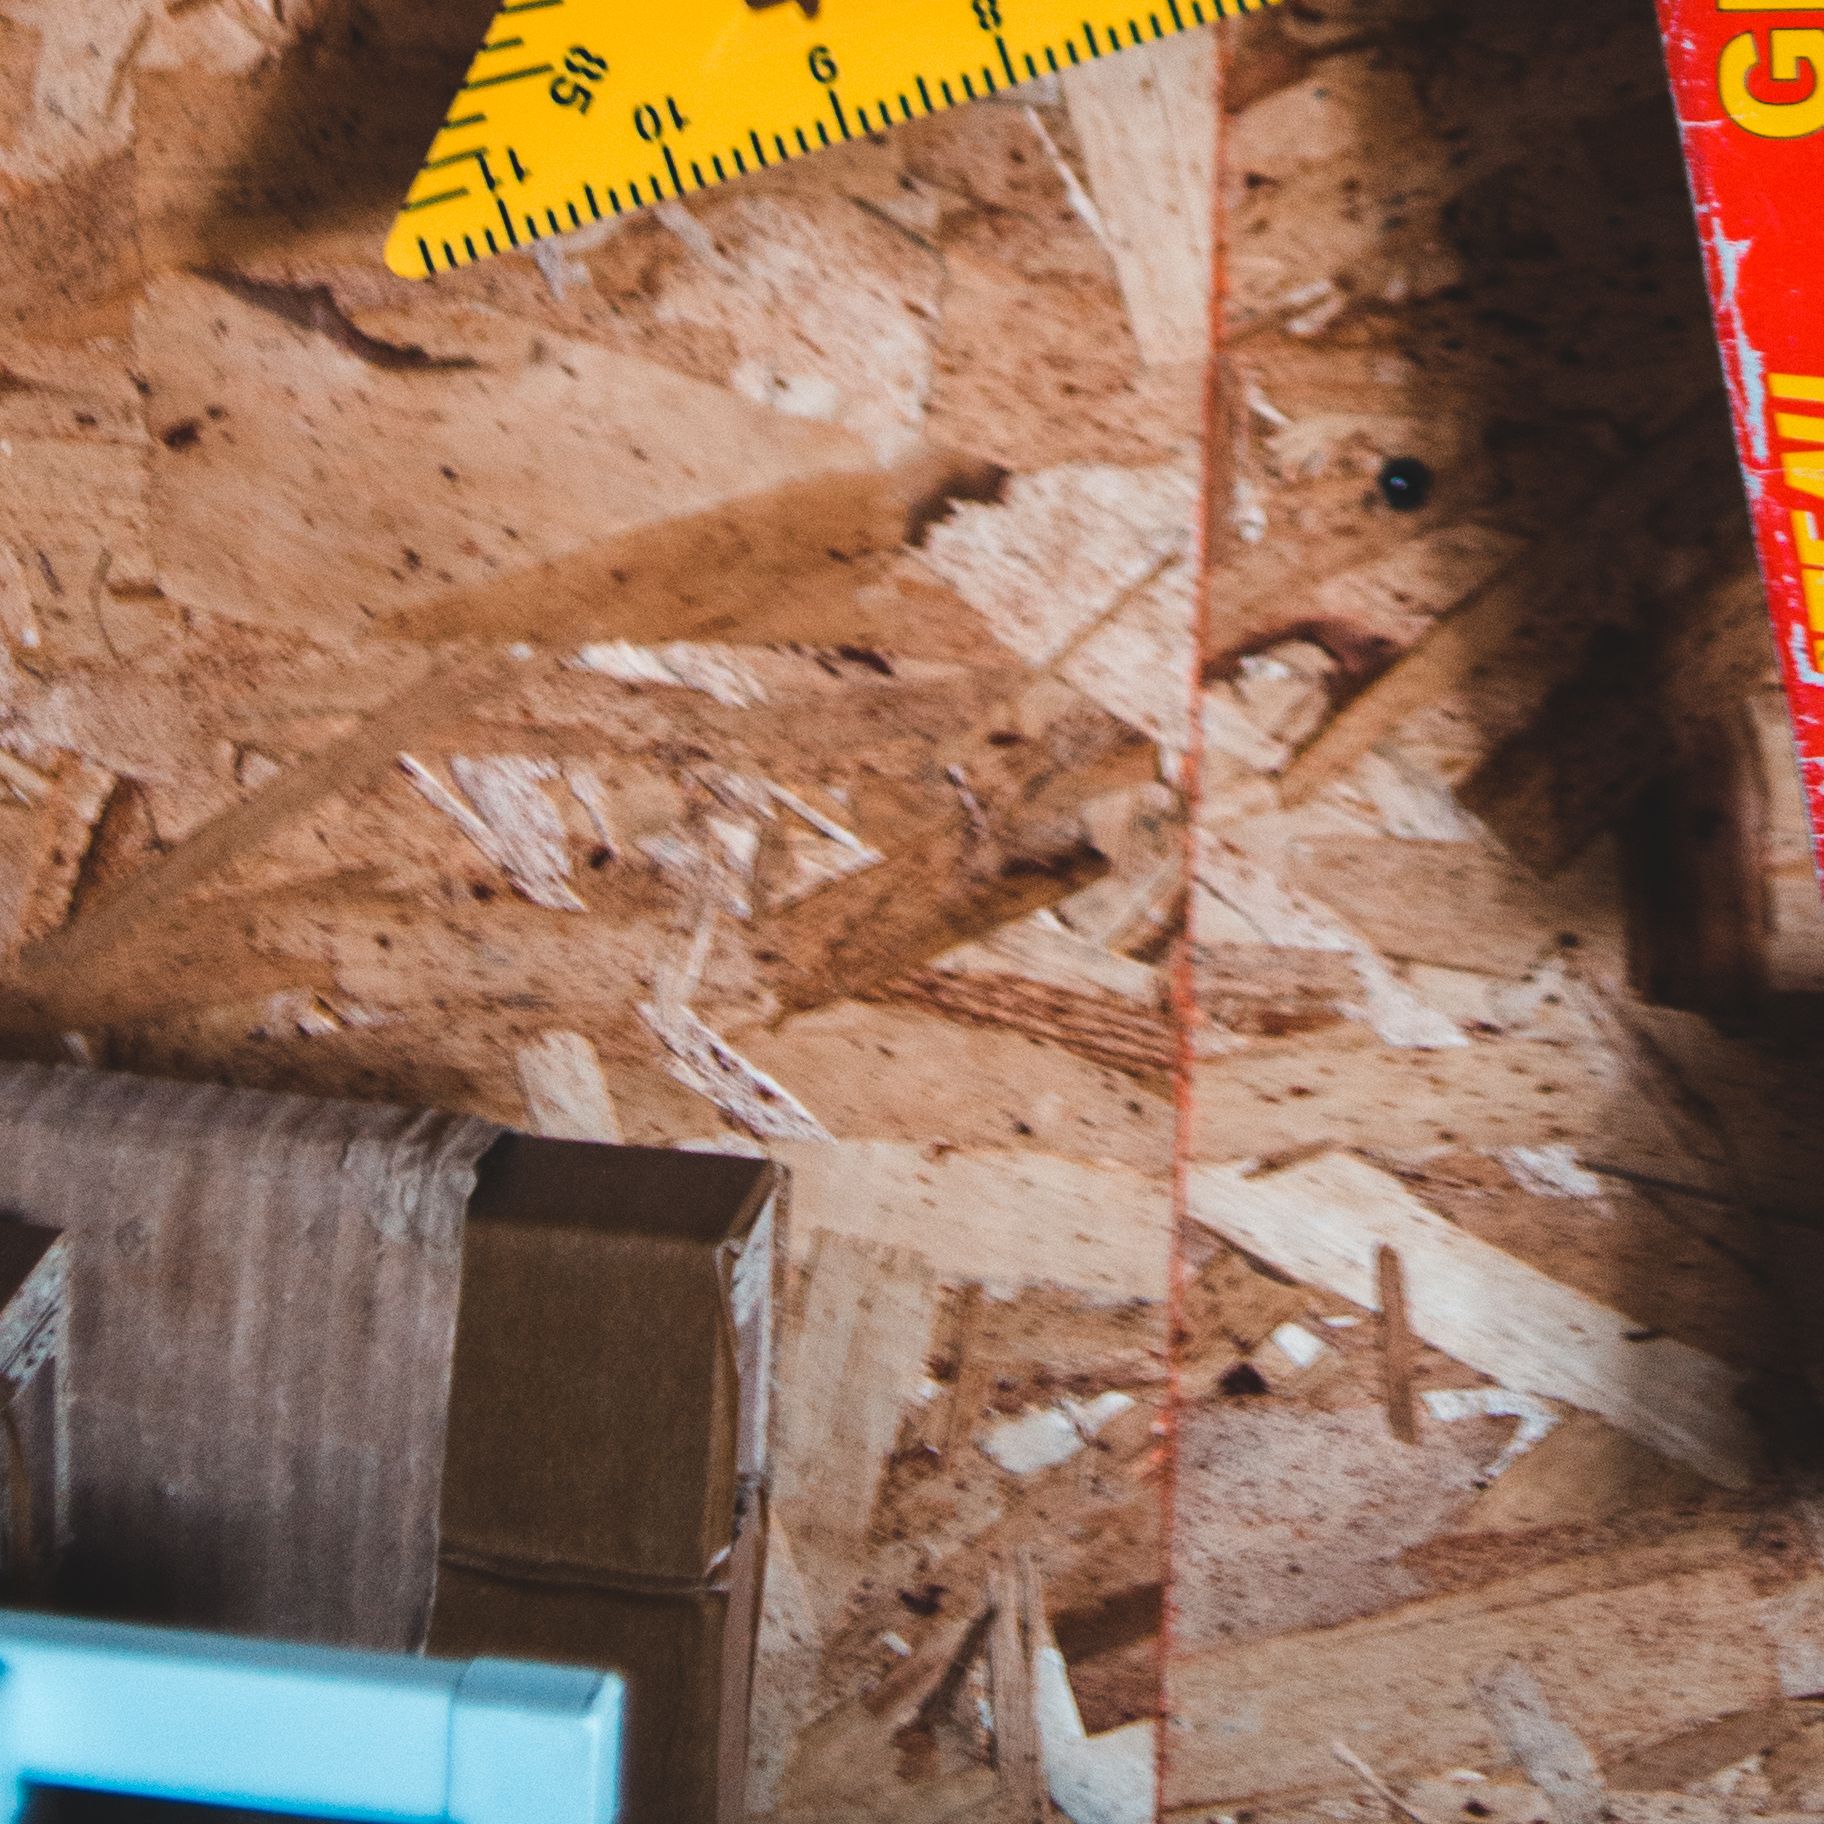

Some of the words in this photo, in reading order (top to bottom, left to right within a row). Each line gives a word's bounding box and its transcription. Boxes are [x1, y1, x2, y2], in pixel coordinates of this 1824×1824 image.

[549, 45, 609, 114] 85
[634, 94, 691, 143] 10
[474, 146, 532, 194] 11
